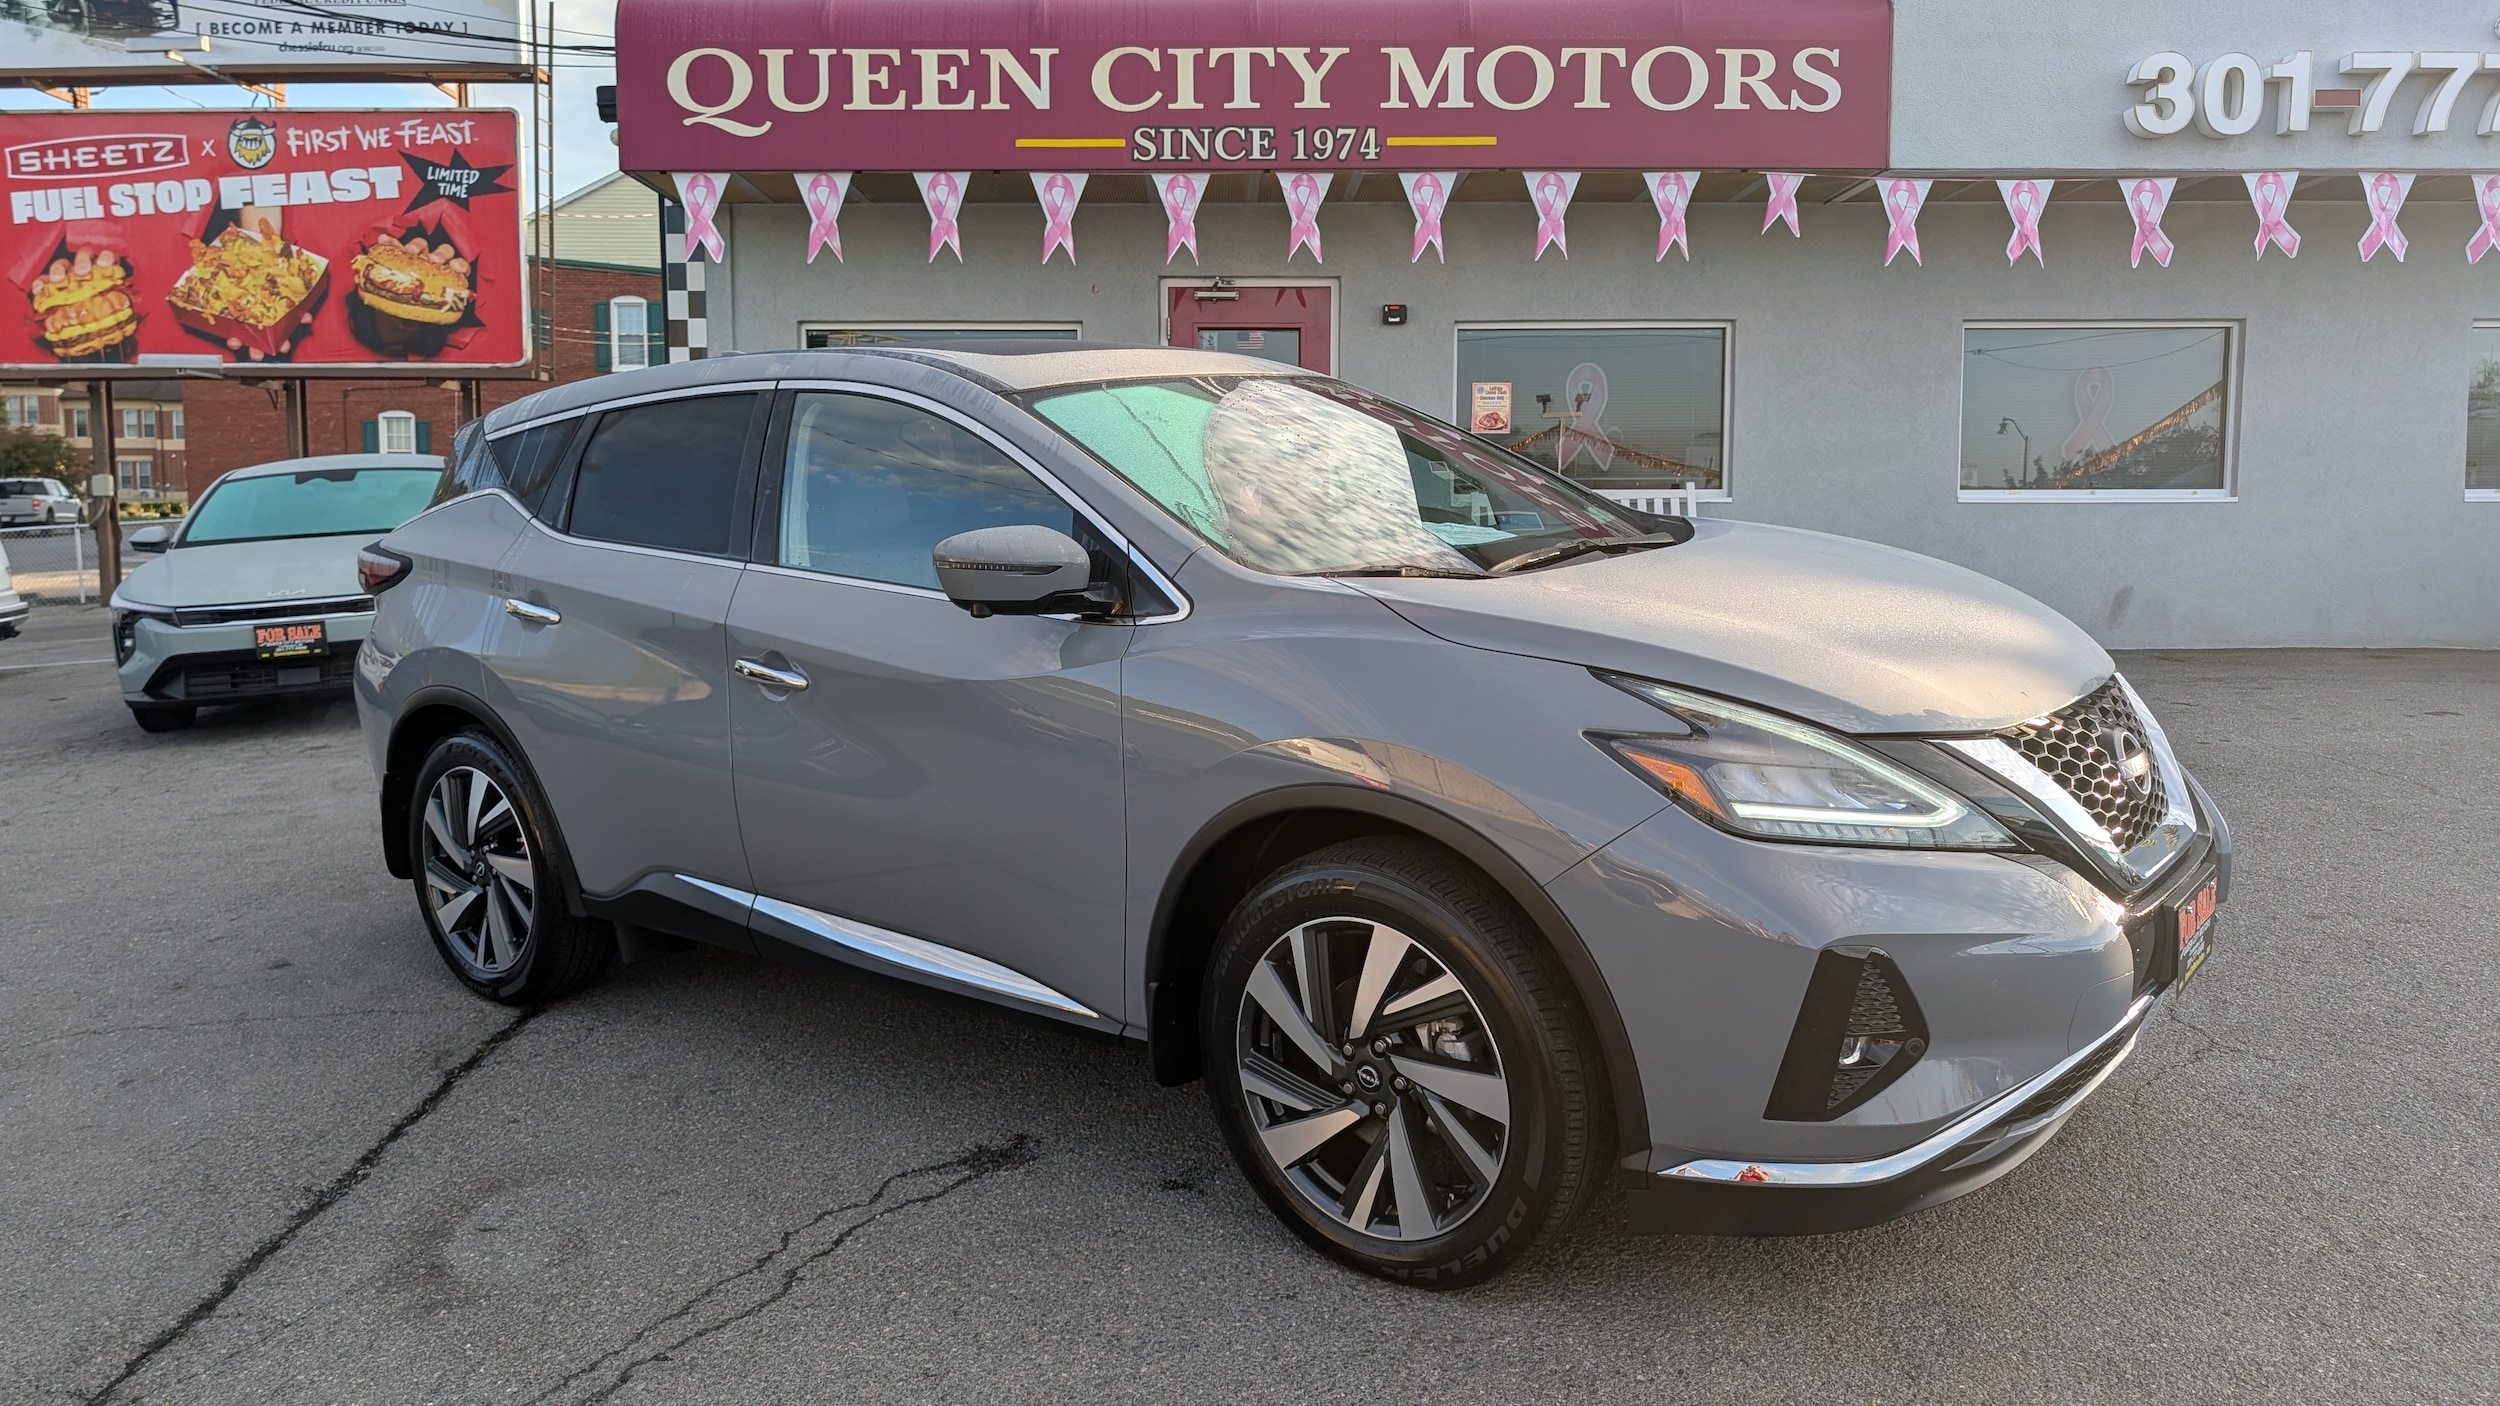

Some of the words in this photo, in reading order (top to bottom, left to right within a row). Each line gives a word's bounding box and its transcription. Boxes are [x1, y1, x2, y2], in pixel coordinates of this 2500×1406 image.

[210, 22, 283, 35] BECOME
[290, 22, 303, 35] A
[311, 21, 387, 35] MEMBER
[666, 46, 1060, 137] QUEEN
[1089, 46, 1350, 112] CITY
[1379, 45, 1844, 112] MOTORS
[18, 140, 177, 173] SHEETZ
[286, 125, 352, 157] FIRST
[353, 124, 393, 151] WE
[394, 118, 476, 148] FEAST
[1131, 125, 1278, 162] SINCE
[1291, 126, 1382, 161] 1974
[426, 165, 480, 185] LIMITED
[10, 185, 105, 224] FUEL
[108, 178, 213, 217] STOP
[218, 165, 403, 210] FEAST
[437, 182, 469, 199] TIME
[257, 627, 286, 644] FOR
[286, 624, 322, 641] SALE
